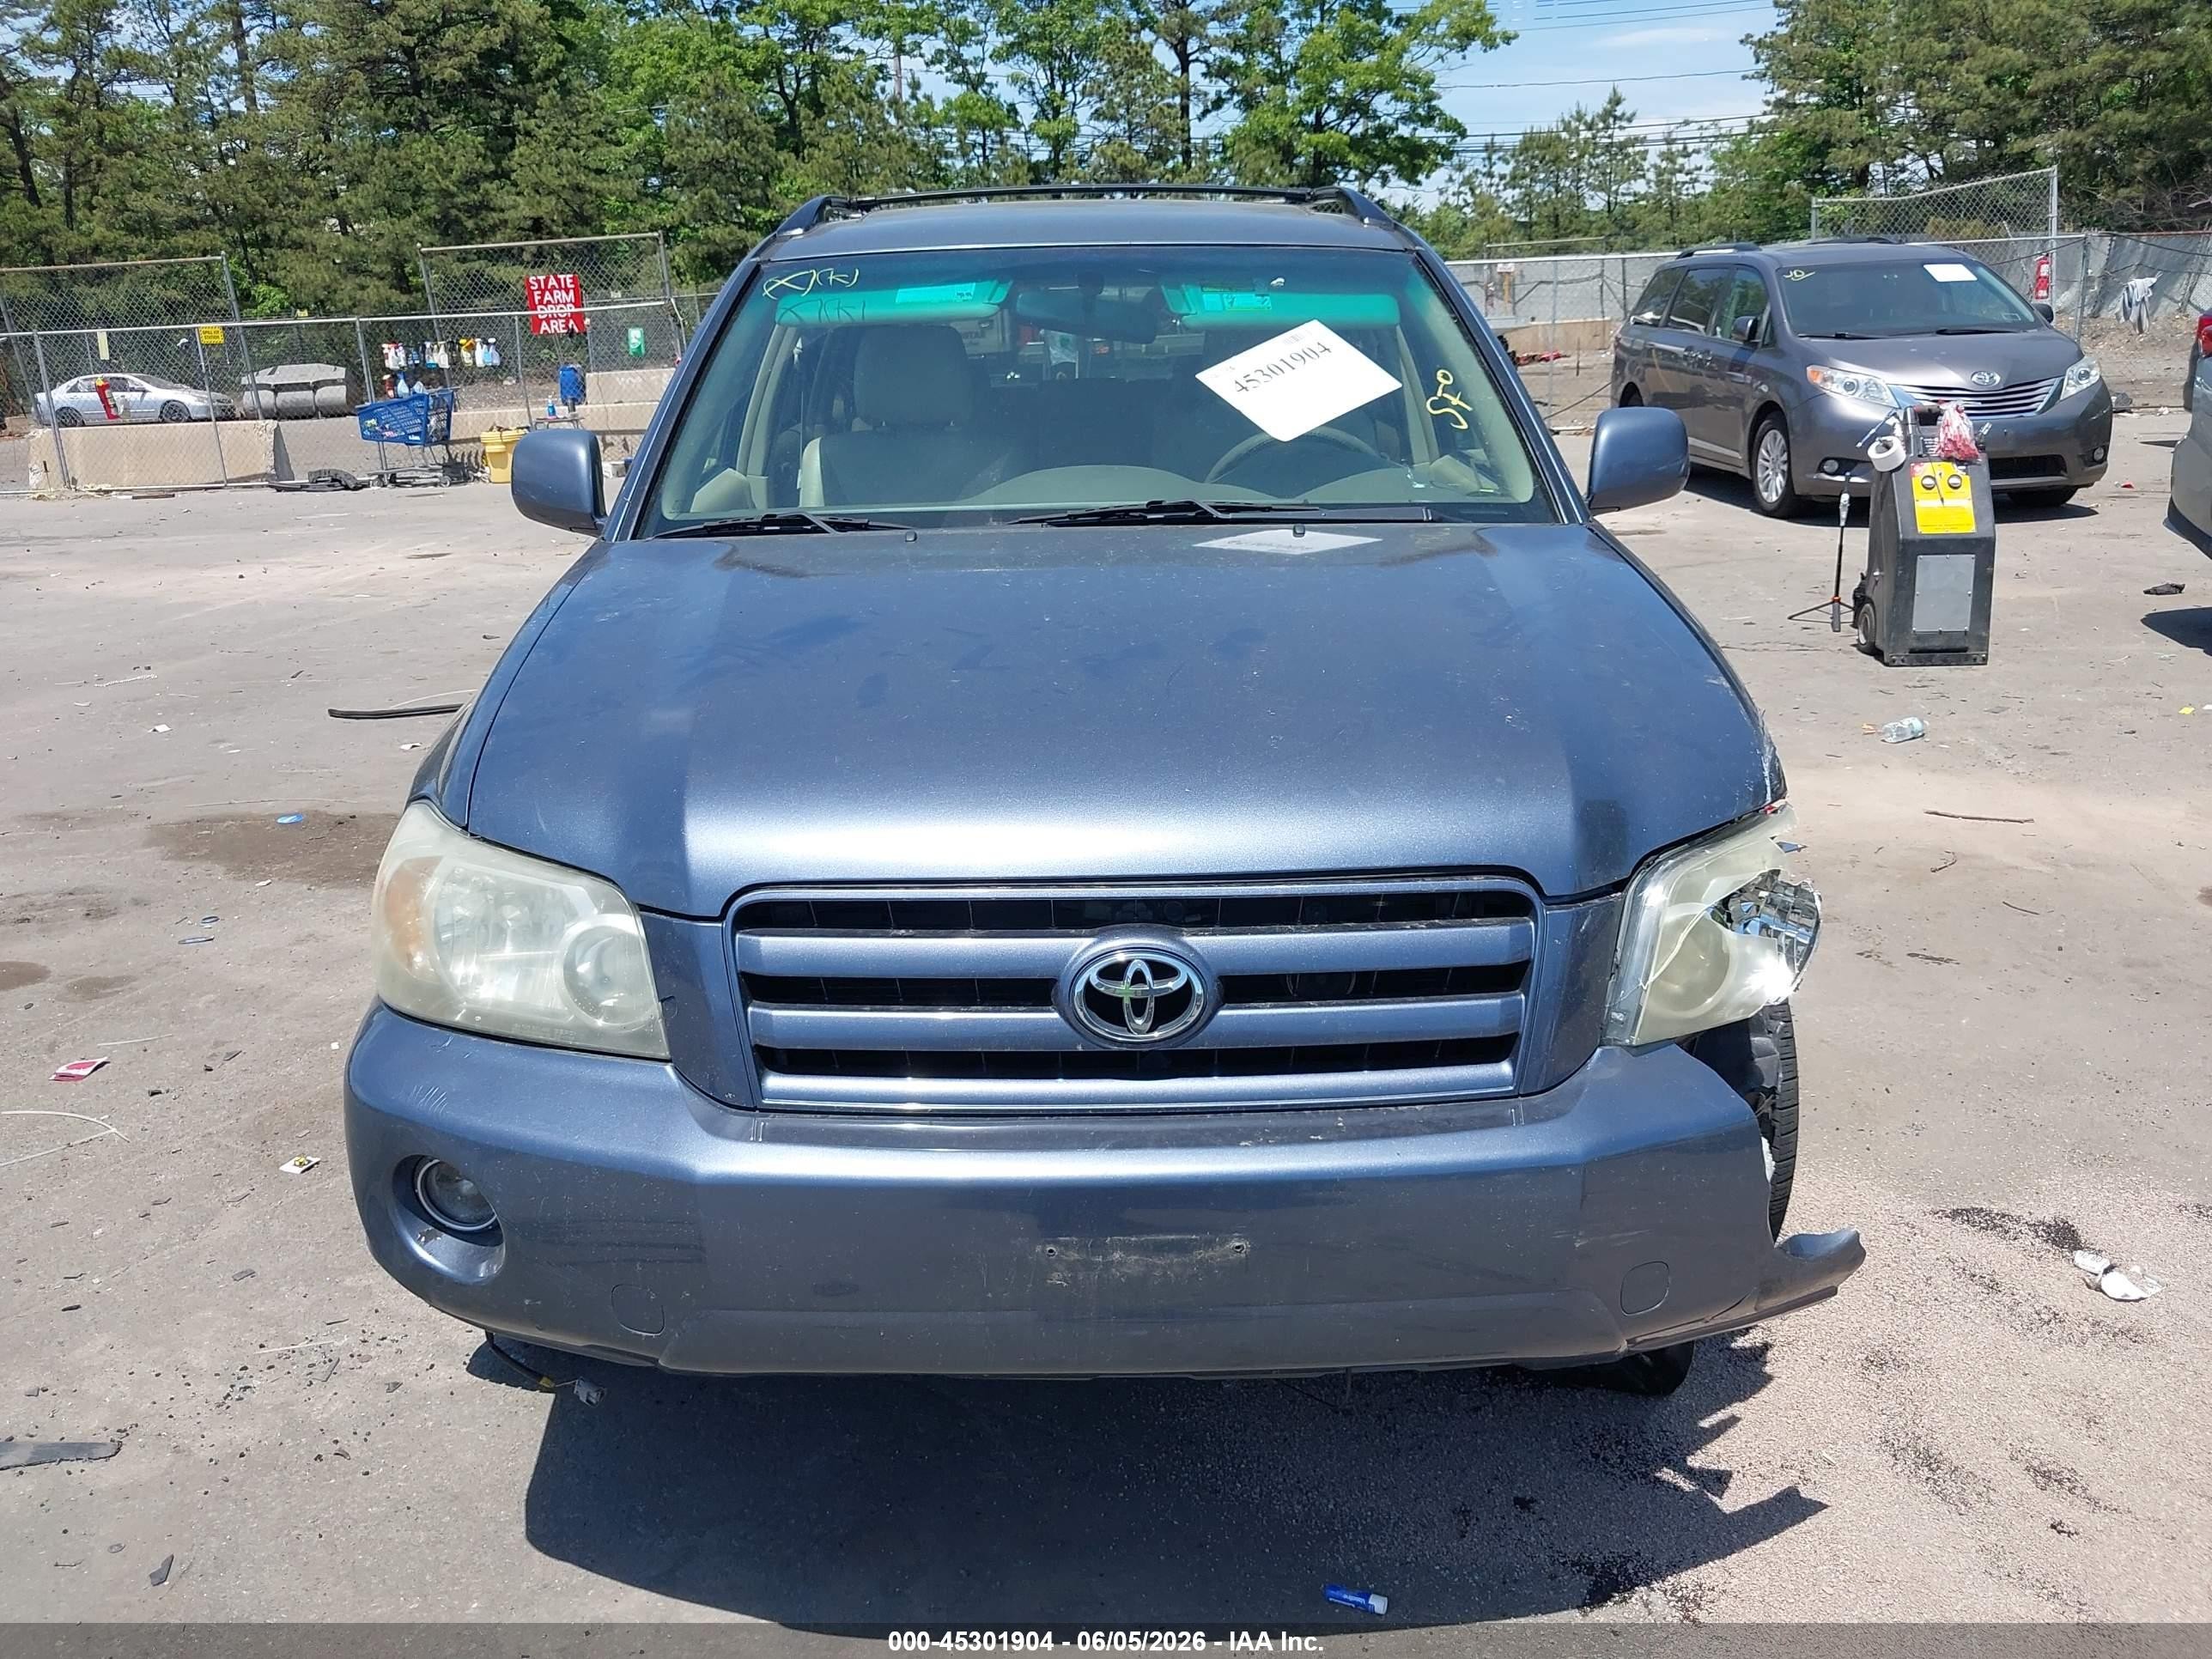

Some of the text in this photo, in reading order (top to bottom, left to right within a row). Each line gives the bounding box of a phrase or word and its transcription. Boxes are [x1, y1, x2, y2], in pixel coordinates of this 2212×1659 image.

[528, 274, 575, 290] STATE
[533, 289, 575, 305] FARM
[536, 304, 575, 319] DROP
[539, 319, 579, 335] AREA
[1233, 341, 1333, 394] 45301904
